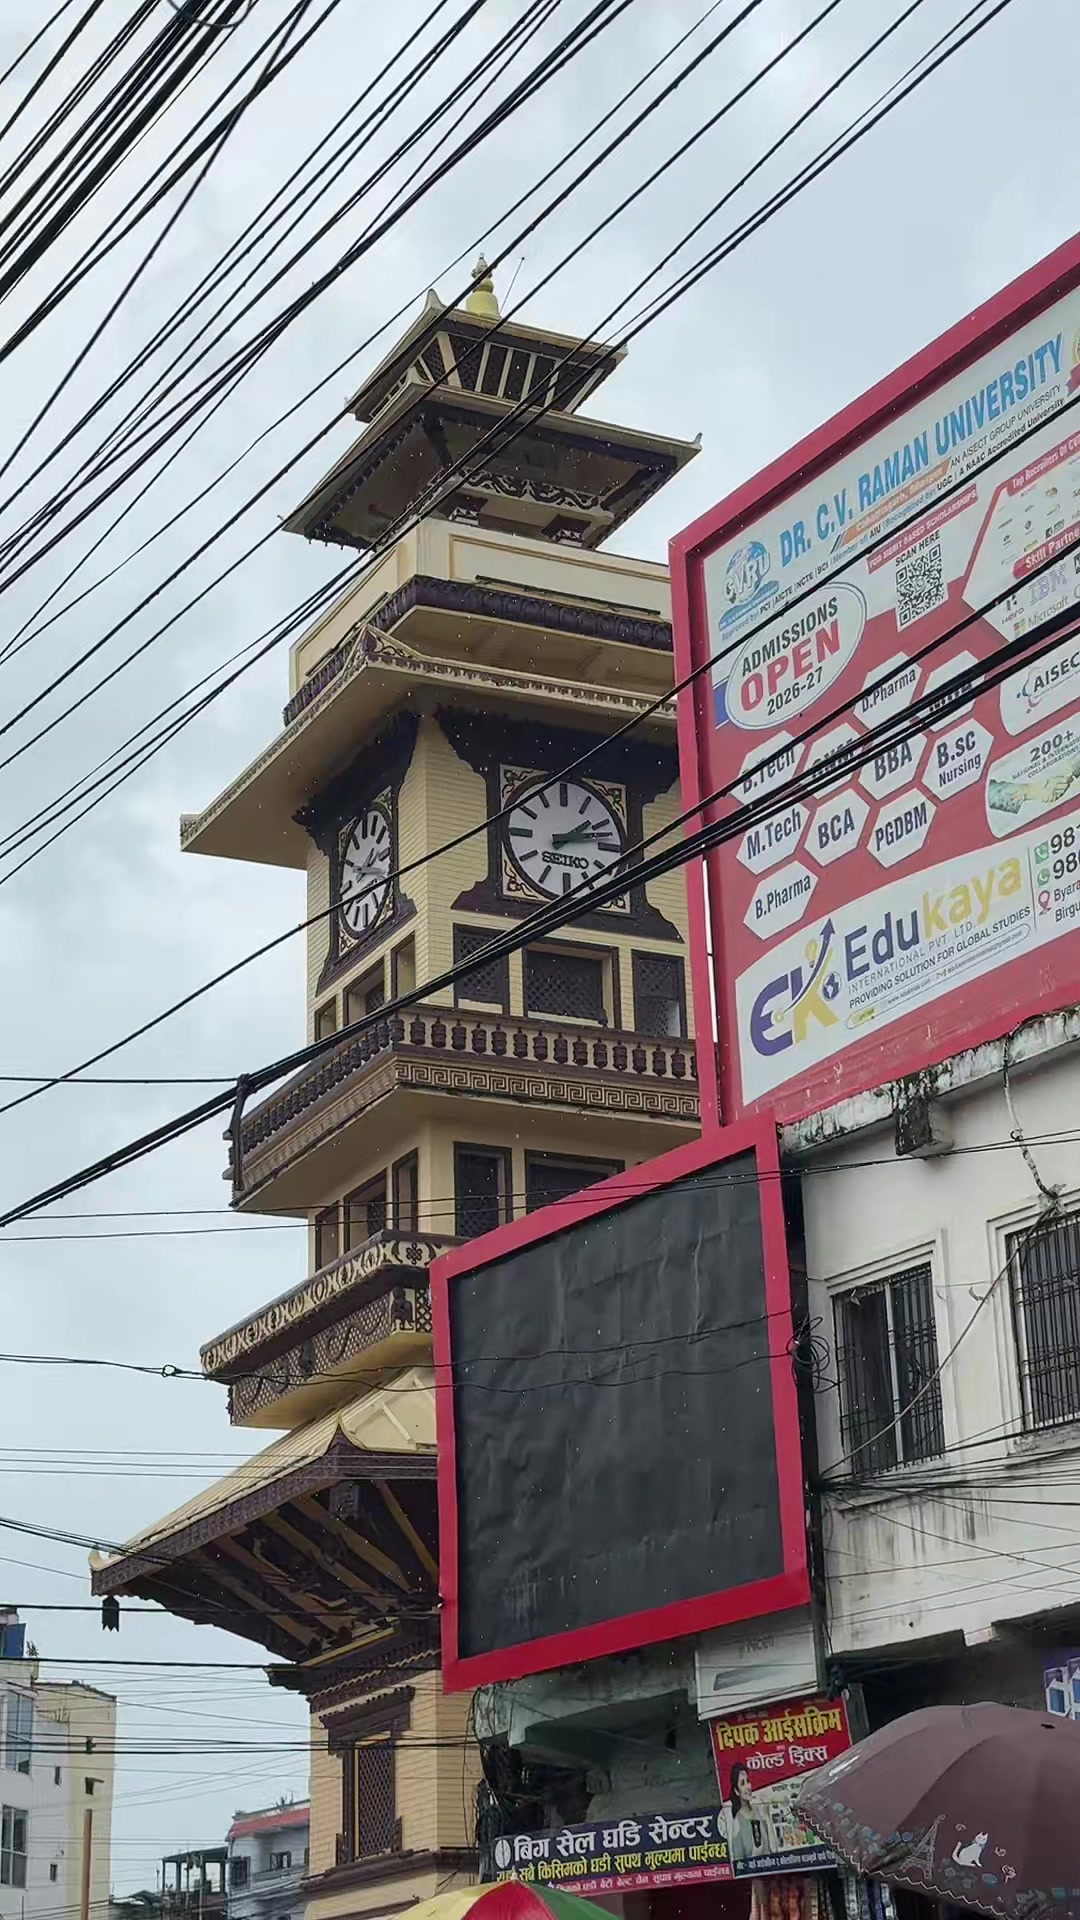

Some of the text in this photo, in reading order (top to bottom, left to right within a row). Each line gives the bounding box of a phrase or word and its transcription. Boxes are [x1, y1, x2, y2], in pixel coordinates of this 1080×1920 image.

[936, 474, 953, 490] UGC
[987, 426, 1026, 456] Accredited
[1028, 398, 1064, 429] University
[950, 384, 1061, 468] AN AISECT GROUP UNIVERSITY
[780, 332, 1063, 568] DR. C.V. RAMAN UNIVERSITY
[895, 530, 940, 566] SCAN HERE
[1025, 549, 1047, 568] Skill
[1028, 596, 1069, 627] Microsoft
[742, 597, 838, 676] ADMISSIONS
[741, 619, 840, 711] OPEN
[767, 666, 823, 716] 2026-27
[862, 669, 916, 713] D.Pharma
[874, 741, 913, 782] BBA
[1030, 730, 1074, 763] 200+
[939, 754, 981, 787] Nursing
[746, 808, 801, 860] M.Tech
[817, 808, 855, 850] BCA
[875, 801, 927, 852] PGDBM
[1051, 824, 1080, 854] 98
[542, 851, 589, 869] SEIKO
[1053, 850, 1080, 879] 98
[755, 875, 811, 920] B.Pharma
[844, 858, 1022, 981] Edukaya
[848, 949, 926, 994] INTERNATIONAL
[849, 980, 893, 1009] PROVIDING
[894, 954, 936, 985] SOLUTION
[937, 946, 955, 963] FOR
[956, 930, 991, 953] GLOBAL
[992, 906, 1031, 933] STUDIES
[717, 1720, 759, 1751] दिपक
[745, 1751, 785, 1770] कोल्ड
[514, 1815, 713, 1862] बिग सेल घडि सेन्टर
[538, 1858, 587, 1881] किसिमको
[591, 1852, 612, 1873] घडी
[614, 1852, 642, 1874] सुपथ
